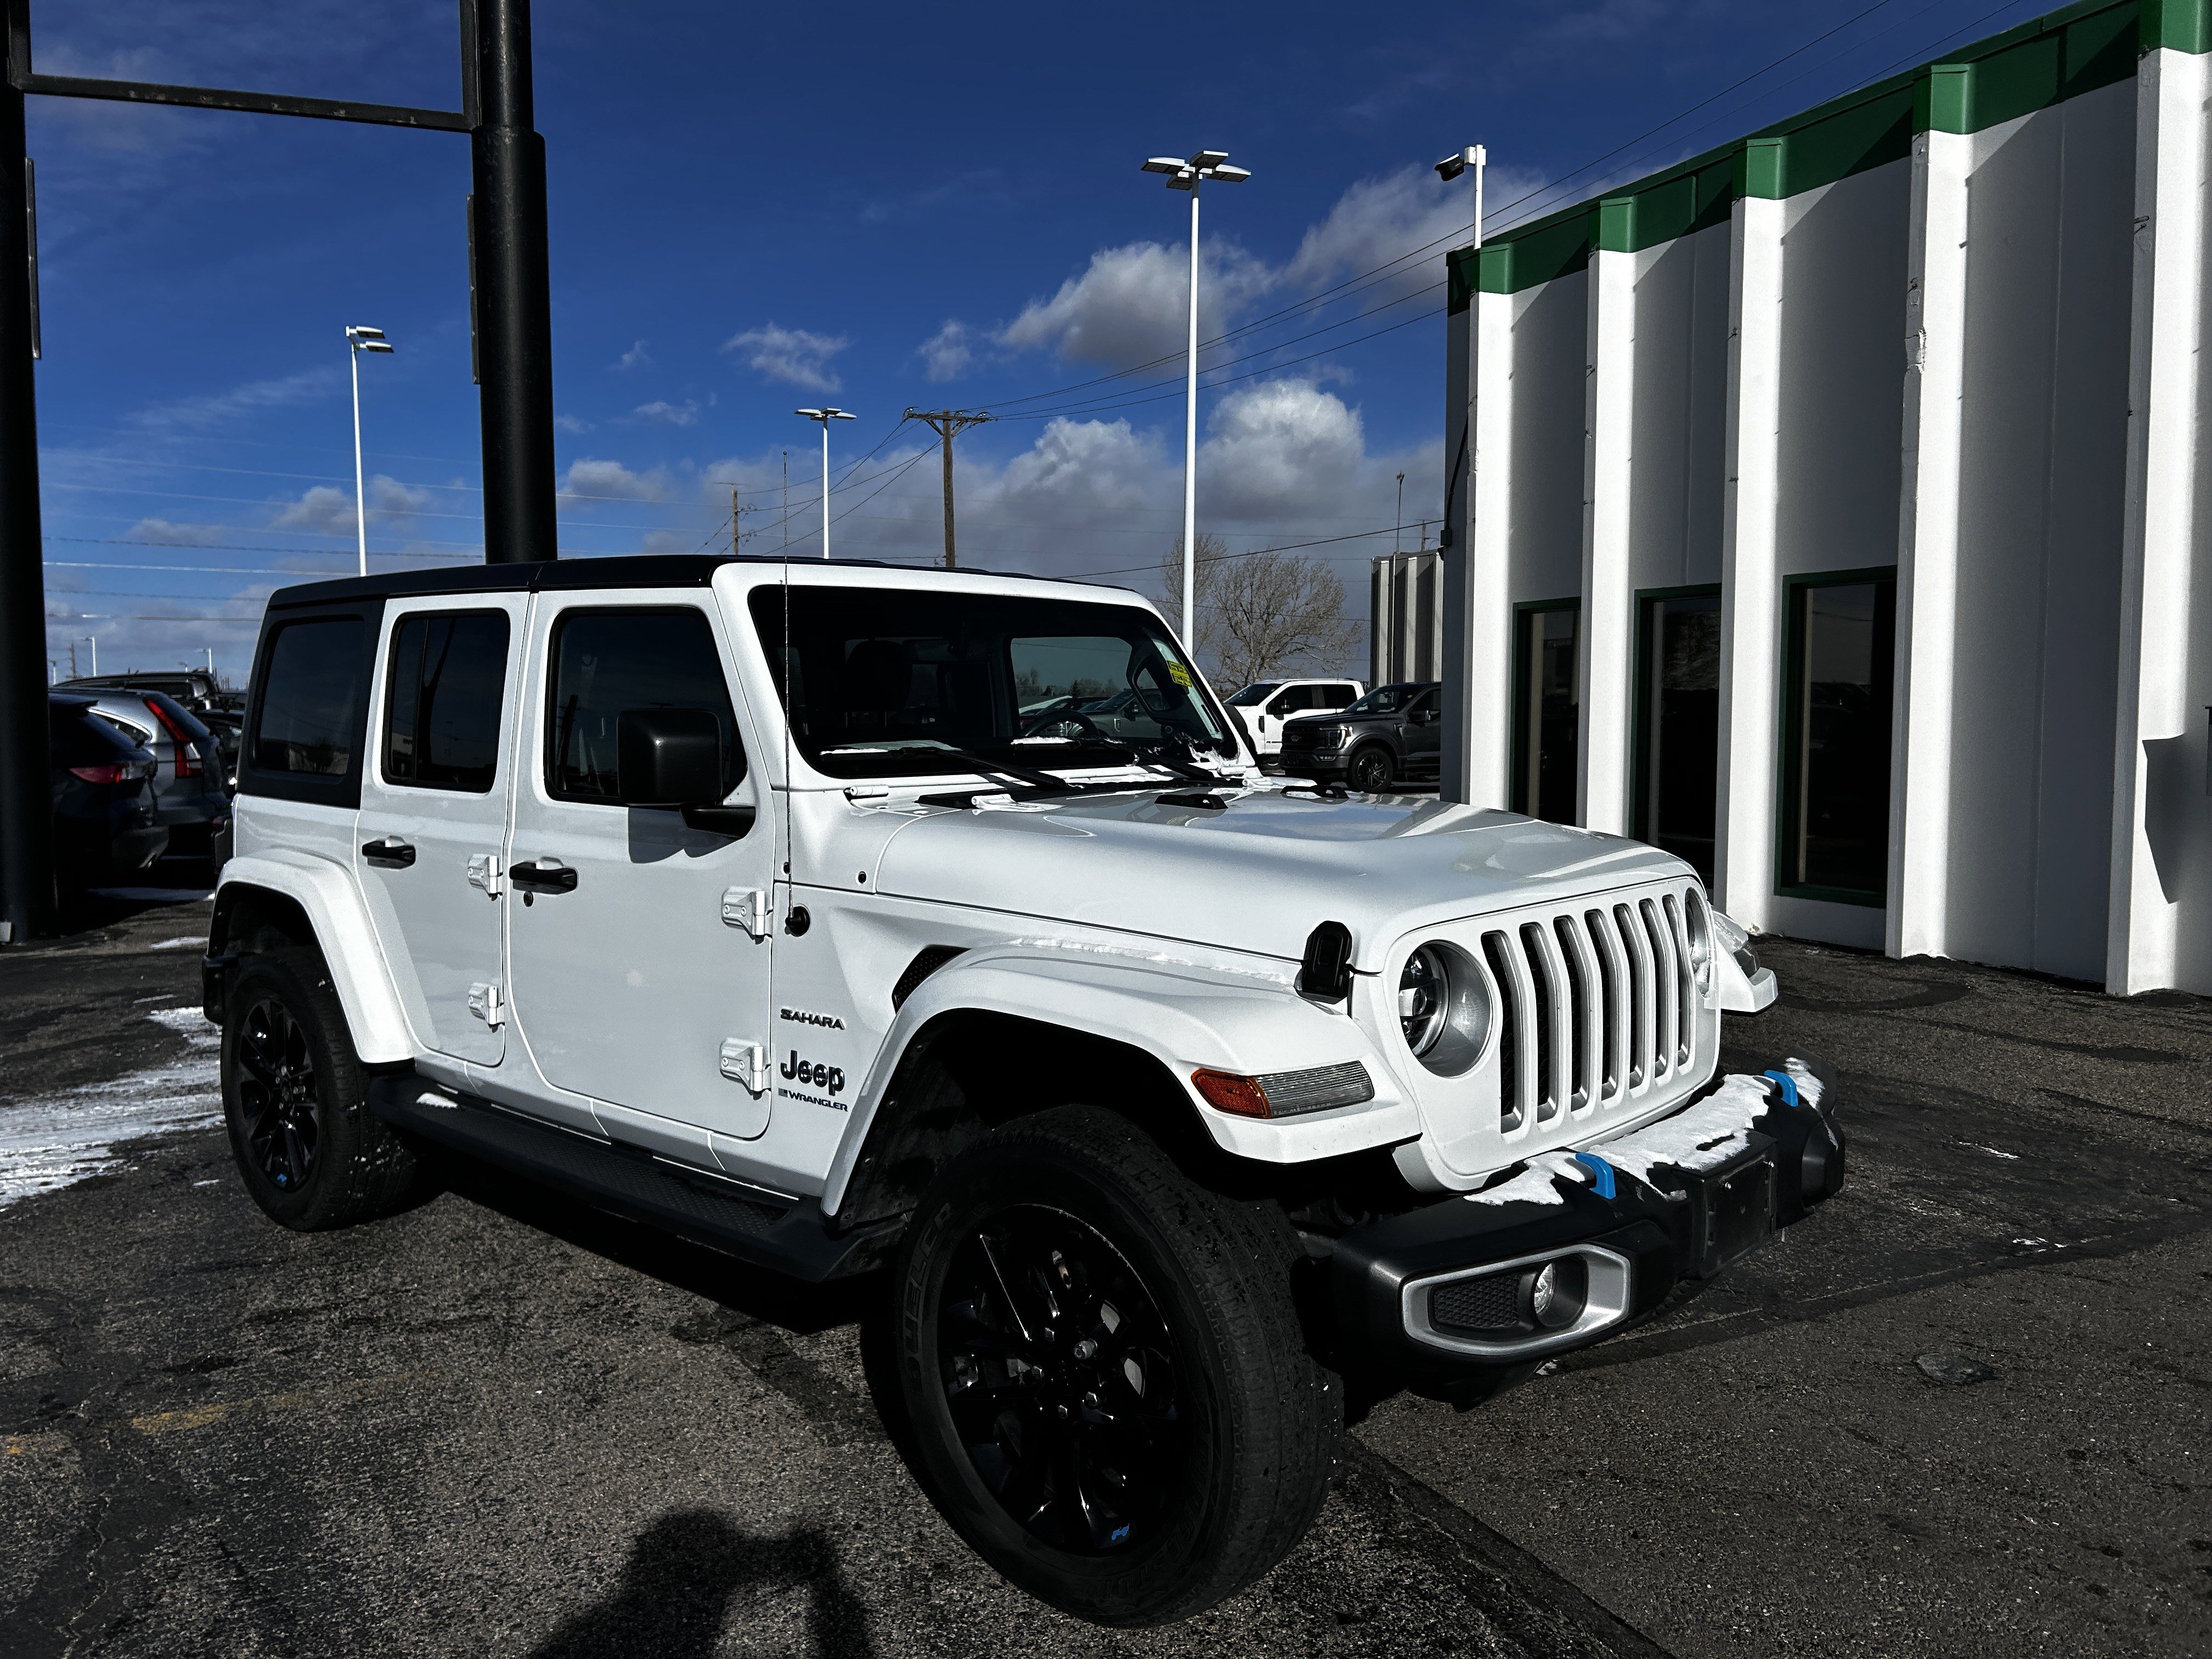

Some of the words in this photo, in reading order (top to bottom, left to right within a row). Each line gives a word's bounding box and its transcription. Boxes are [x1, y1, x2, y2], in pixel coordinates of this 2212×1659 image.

[780, 1008, 845, 1030] SAHARA
[780, 1049, 845, 1097] Jeep
[788, 1090, 848, 1112] WRANGLER
